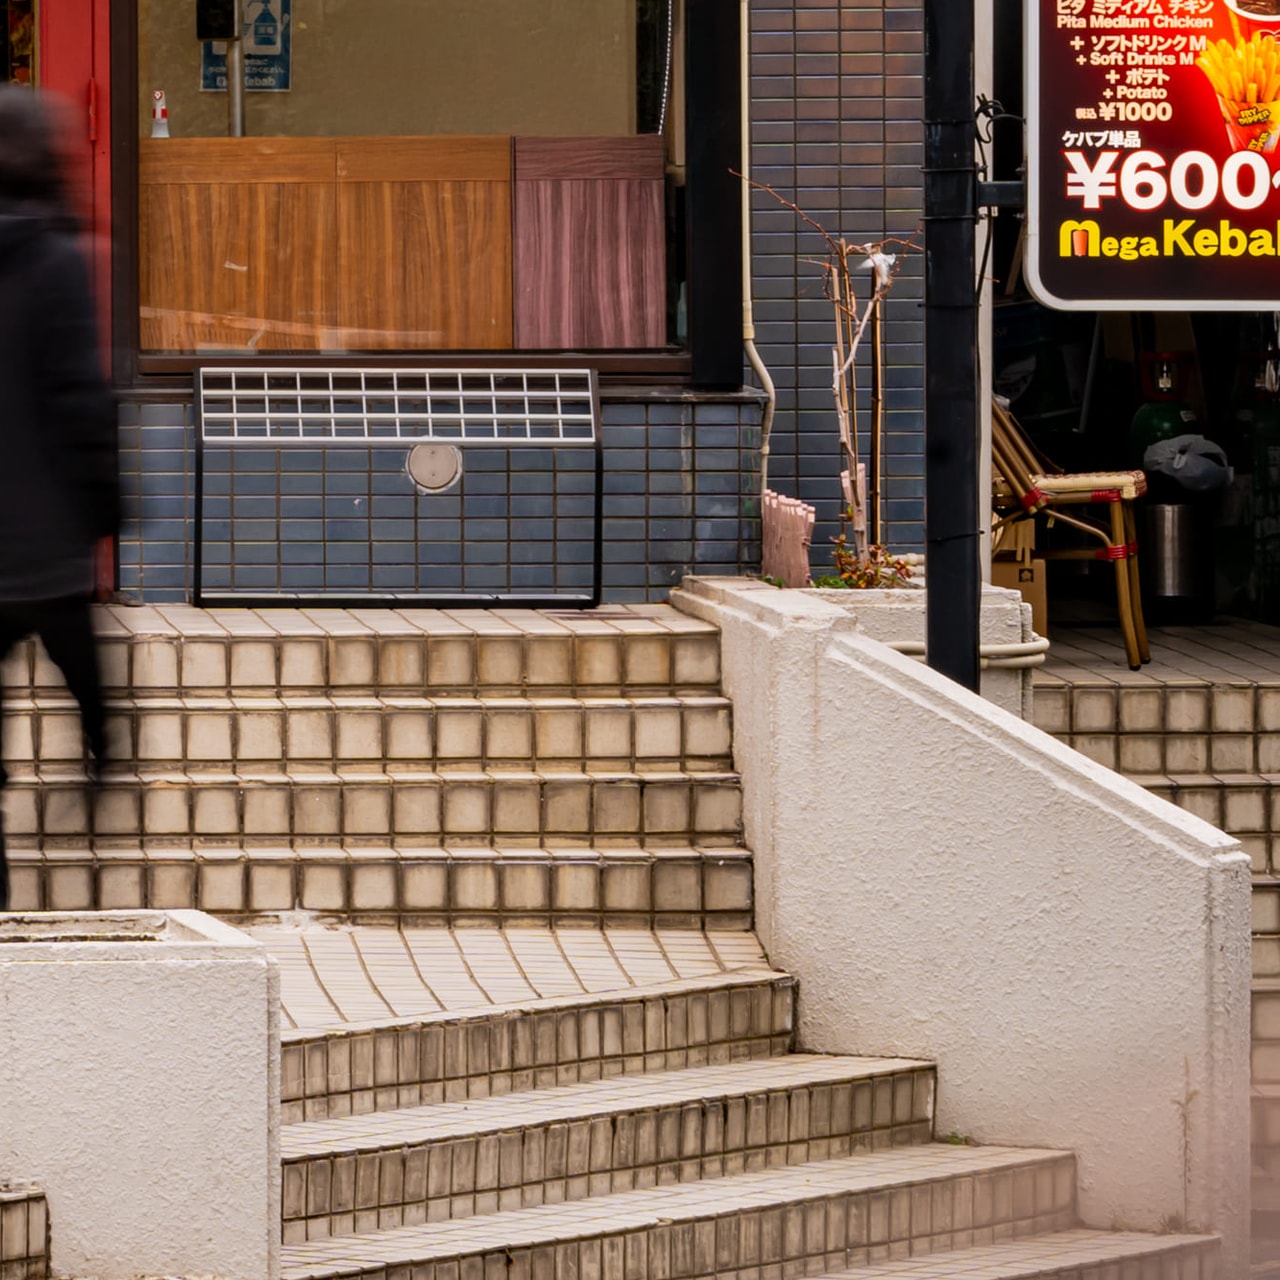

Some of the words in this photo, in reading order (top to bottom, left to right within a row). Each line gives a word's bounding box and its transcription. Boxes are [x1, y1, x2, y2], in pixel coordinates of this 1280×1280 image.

[1093, 0, 1162, 14] ミディアム
[1057, 16, 1087, 28] Pita
[1090, 16, 1149, 28] Medium
[1153, 16, 1213, 28] Chicken
[1091, 35, 1188, 51] ソフトドリンク
[1190, 36, 1207, 51] M
[1090, 52, 1124, 65] Soft
[1127, 52, 1177, 65] Drinks
[1180, 53, 1194, 65] M
[1126, 69, 1170, 85] ポテト
[1117, 86, 1167, 99] Potato
[1099, 102, 1172, 121] ¥1000
[1062, 130, 1141, 147] ケバブ単品
[1164, 220, 1280, 257] Keba
